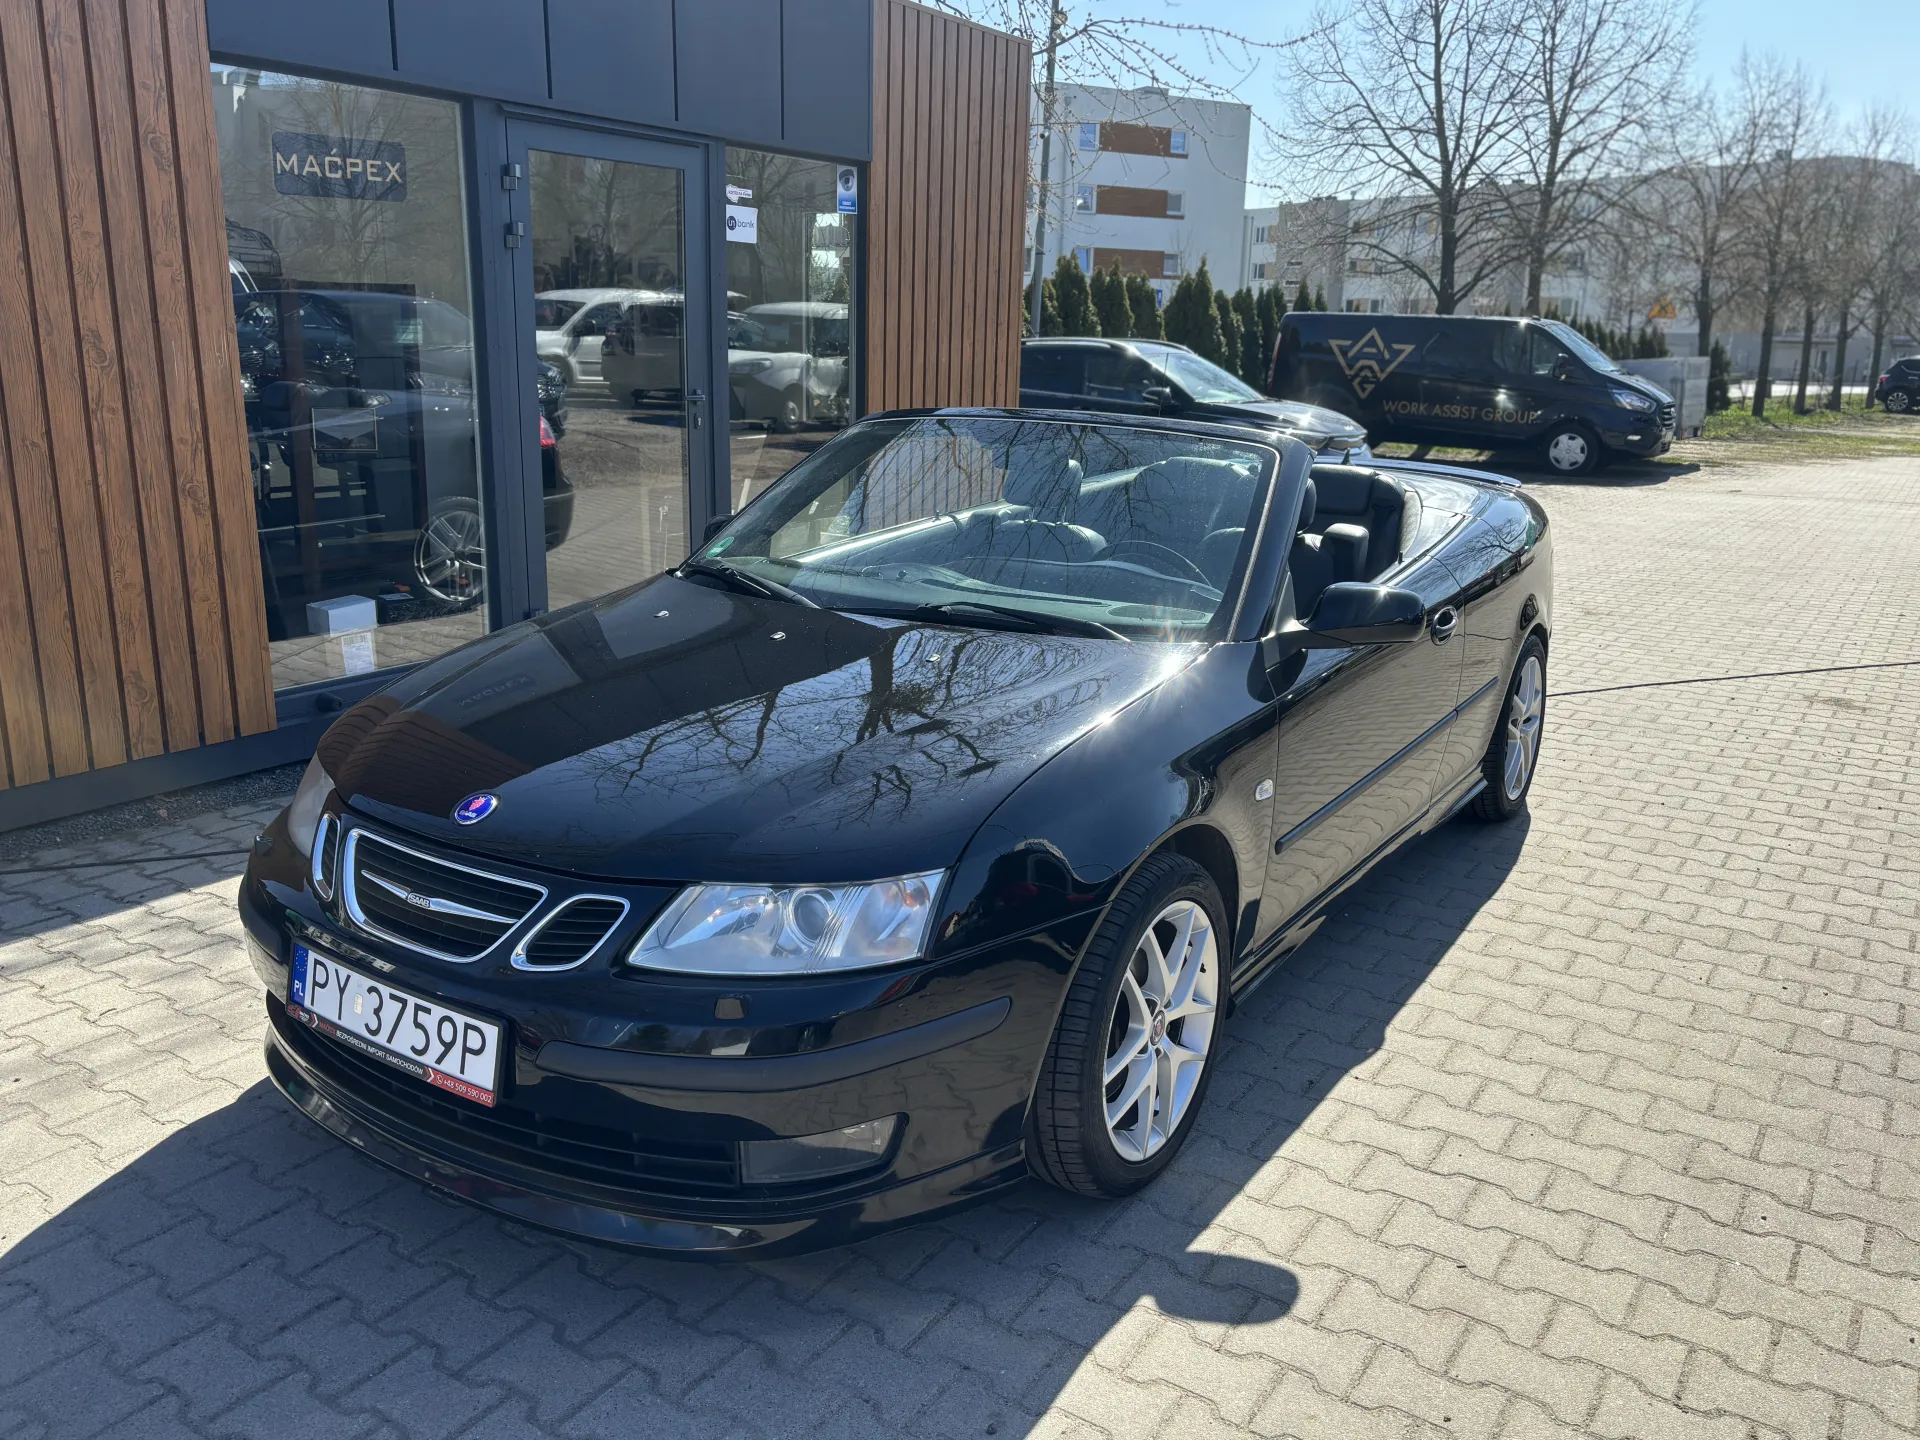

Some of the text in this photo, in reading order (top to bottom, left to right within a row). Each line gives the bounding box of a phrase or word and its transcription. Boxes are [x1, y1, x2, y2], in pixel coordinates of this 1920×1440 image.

[276, 148, 402, 183] MAĆPEX
[1382, 400, 1539, 424] WORK ASSIST GROUP
[410, 894, 430, 907] SAAB
[293, 979, 304, 996] PL
[310, 957, 486, 1075] PY 3759P
[336, 1029, 367, 1051] BEZPOŚREDNI
[366, 1045, 385, 1058] IMPORT
[386, 1053, 424, 1075] SAMOCHODÓW
[443, 1079, 492, 1104] +48 509 590 002
